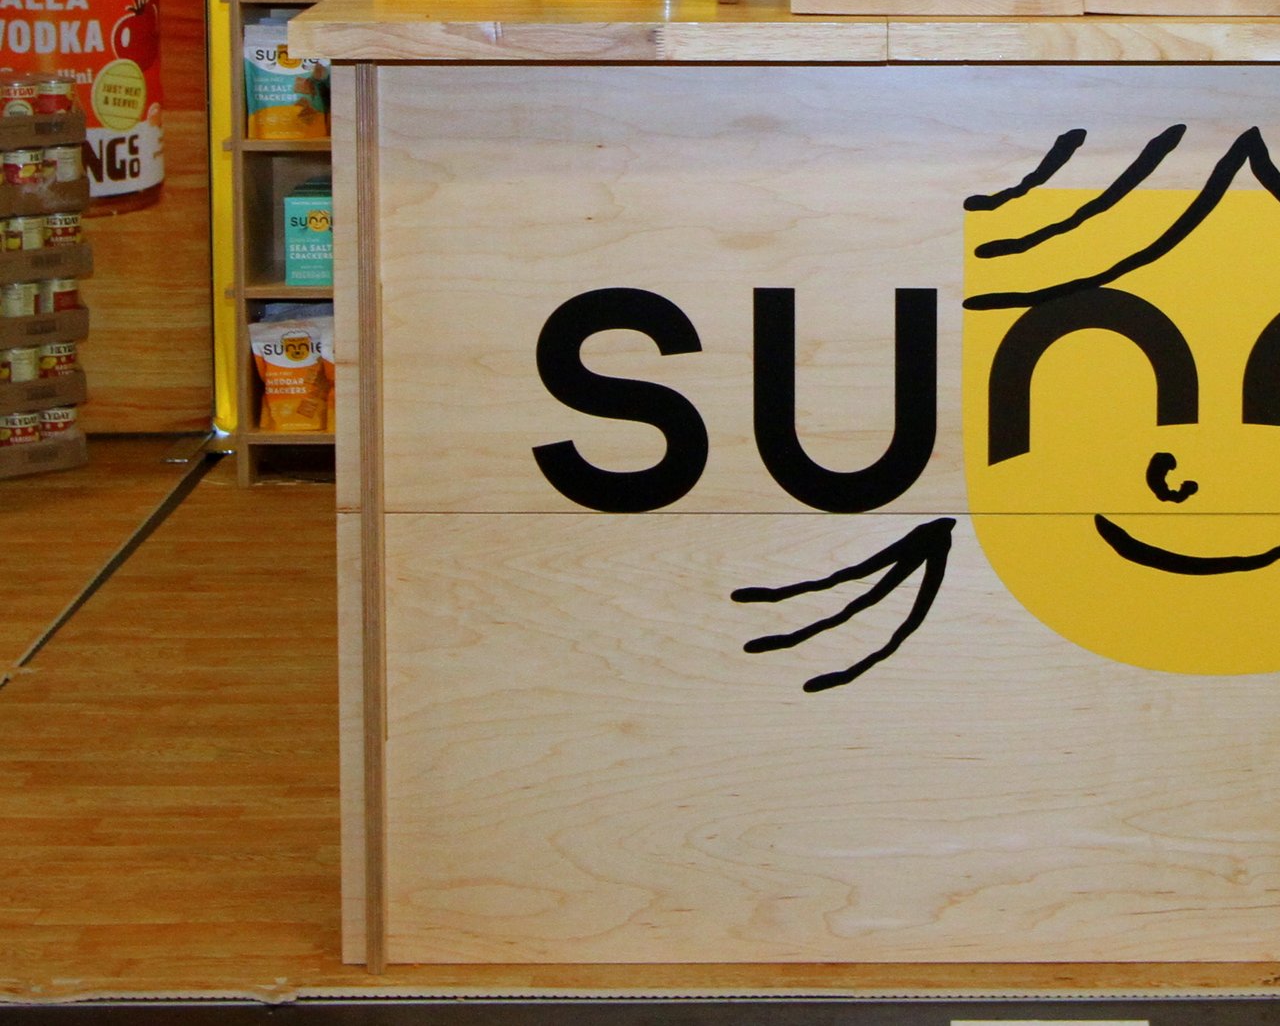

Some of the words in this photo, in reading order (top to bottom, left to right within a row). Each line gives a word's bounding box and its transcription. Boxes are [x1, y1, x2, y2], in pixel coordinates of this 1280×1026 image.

[0, 19, 105, 55] ODKA
[103, 83, 123, 94] JUST
[124, 86, 141, 97] HEAT
[290, 244, 308, 252] SEA
